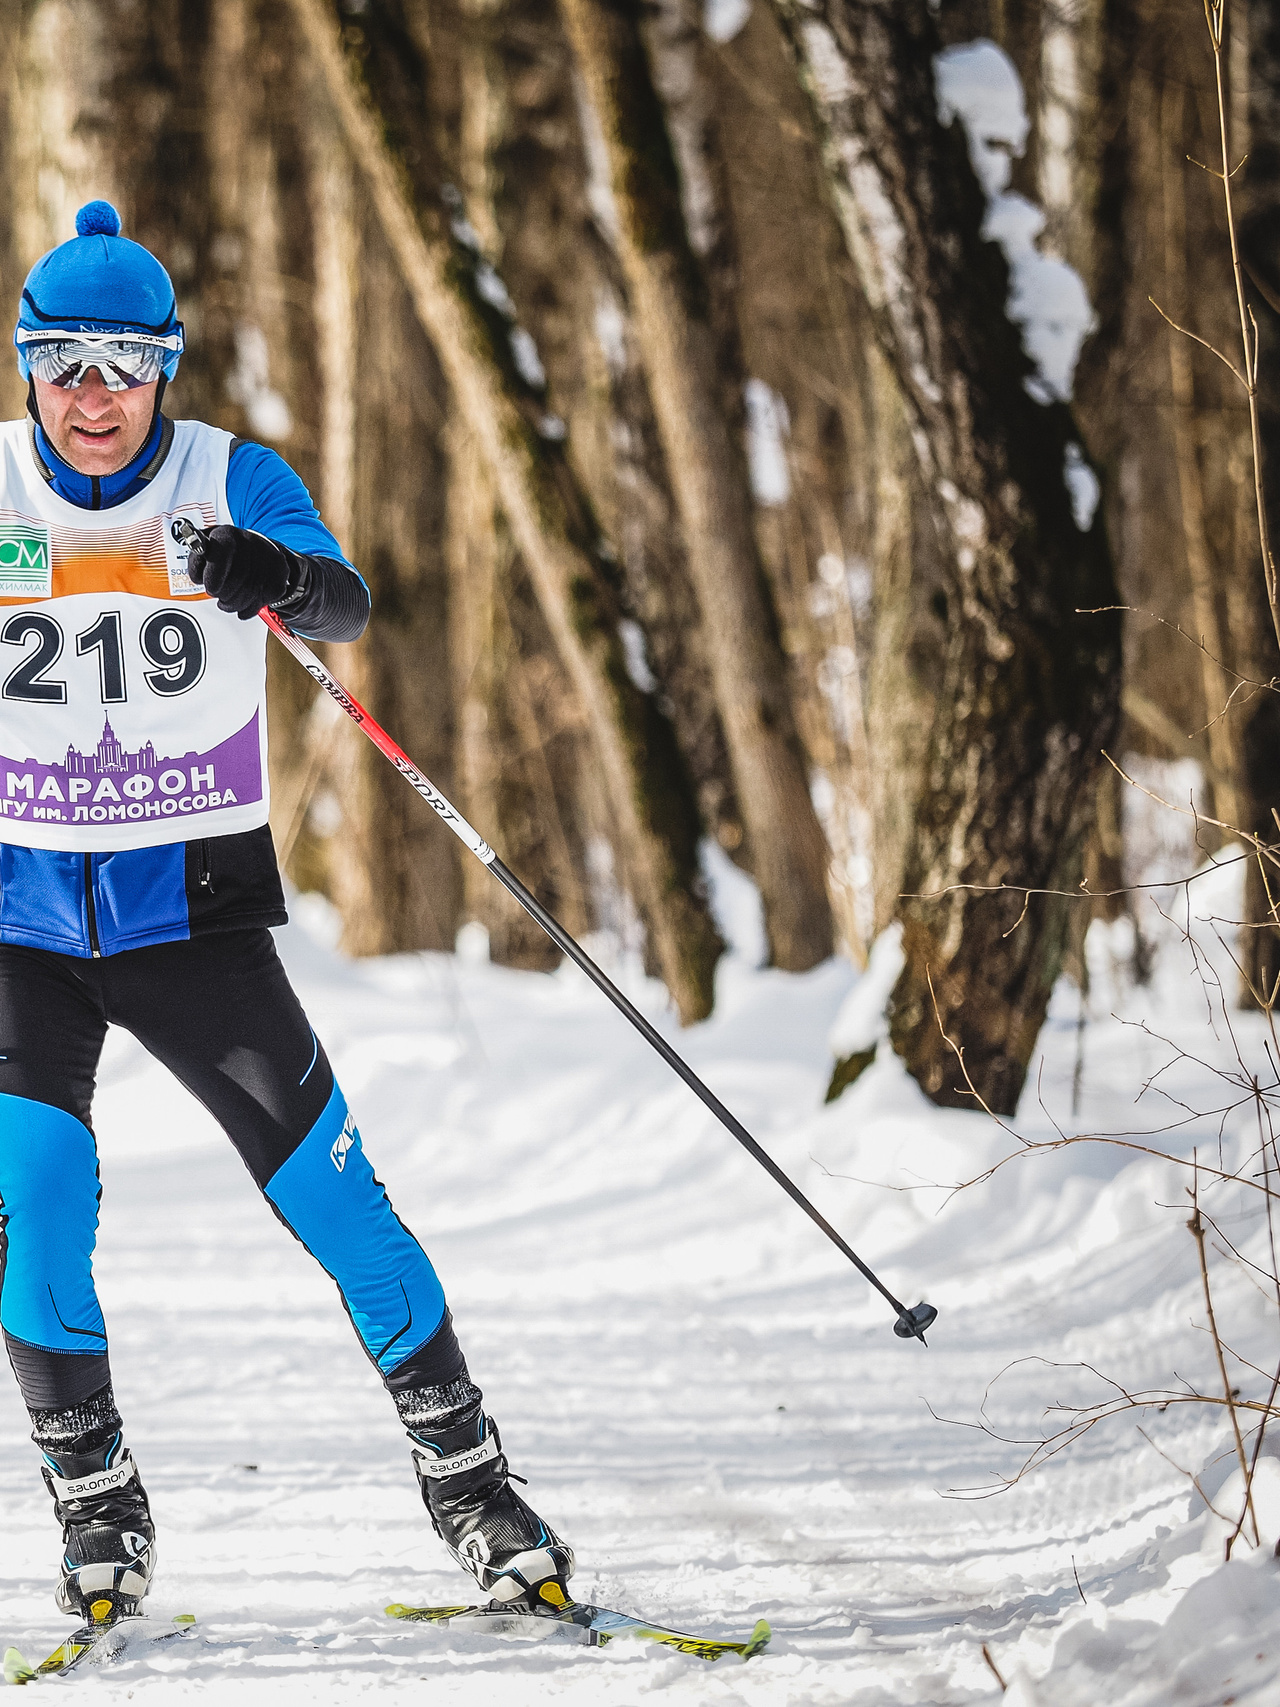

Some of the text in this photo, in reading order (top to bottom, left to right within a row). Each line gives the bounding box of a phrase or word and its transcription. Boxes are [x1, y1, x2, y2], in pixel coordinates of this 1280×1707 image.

[0, 608, 207, 705] 219
[5, 763, 216, 803] МАРАФОН
[72, 788, 238, 822] ЛОМОНОСОВА
[392, 752, 460, 823] SPORT
